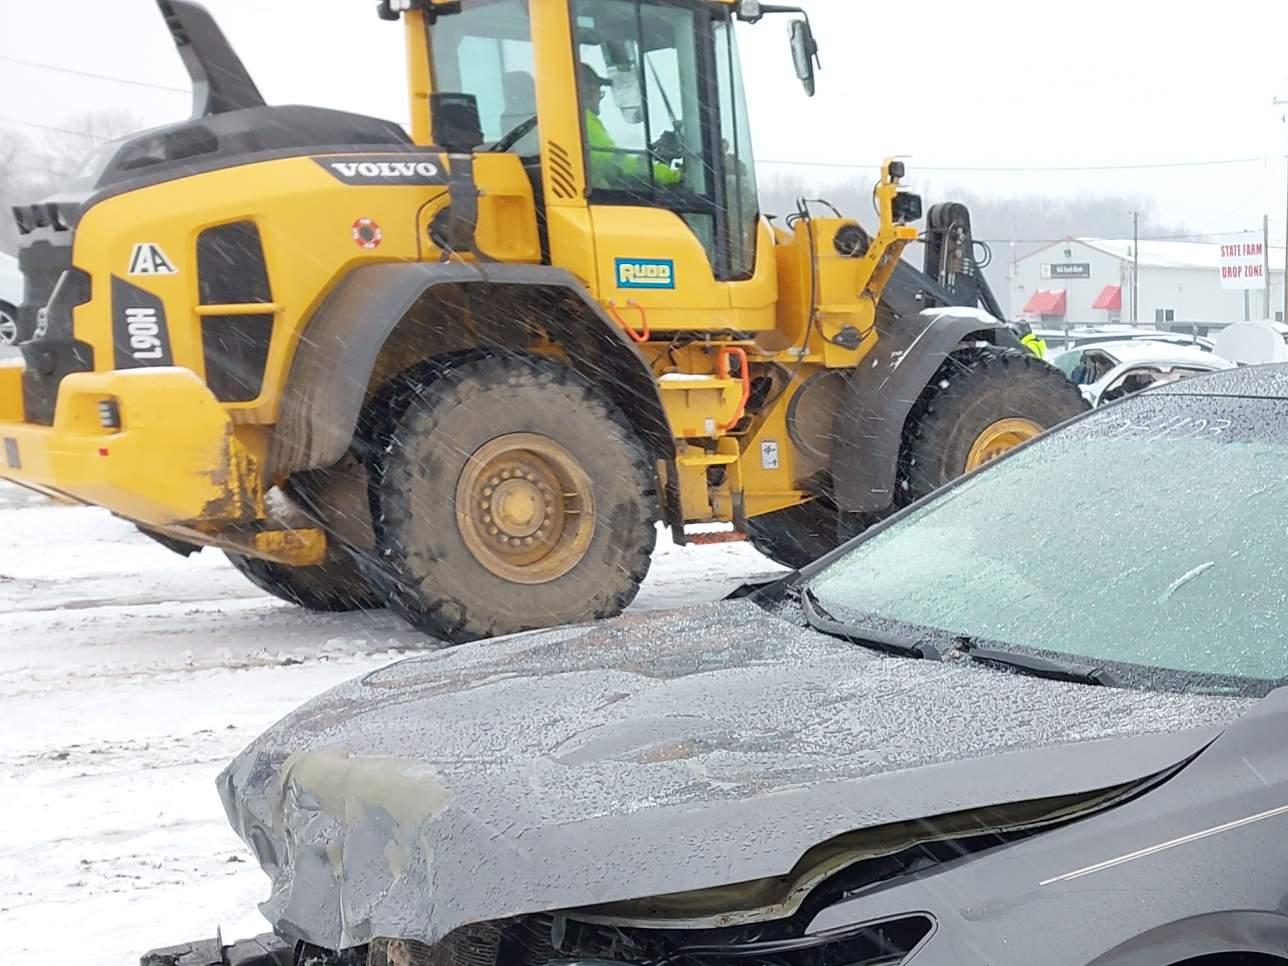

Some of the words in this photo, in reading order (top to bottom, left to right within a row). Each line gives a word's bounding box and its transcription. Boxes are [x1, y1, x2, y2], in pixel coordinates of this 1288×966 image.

[331, 162, 438, 177] VOLVO
[1221, 244, 1241, 258] STATE
[1243, 243, 1263, 256] FARM
[619, 263, 671, 283] RUDD
[1222, 266, 1242, 279] DROP
[1244, 265, 1264, 277] ZONE
[125, 307, 163, 359] L90H
